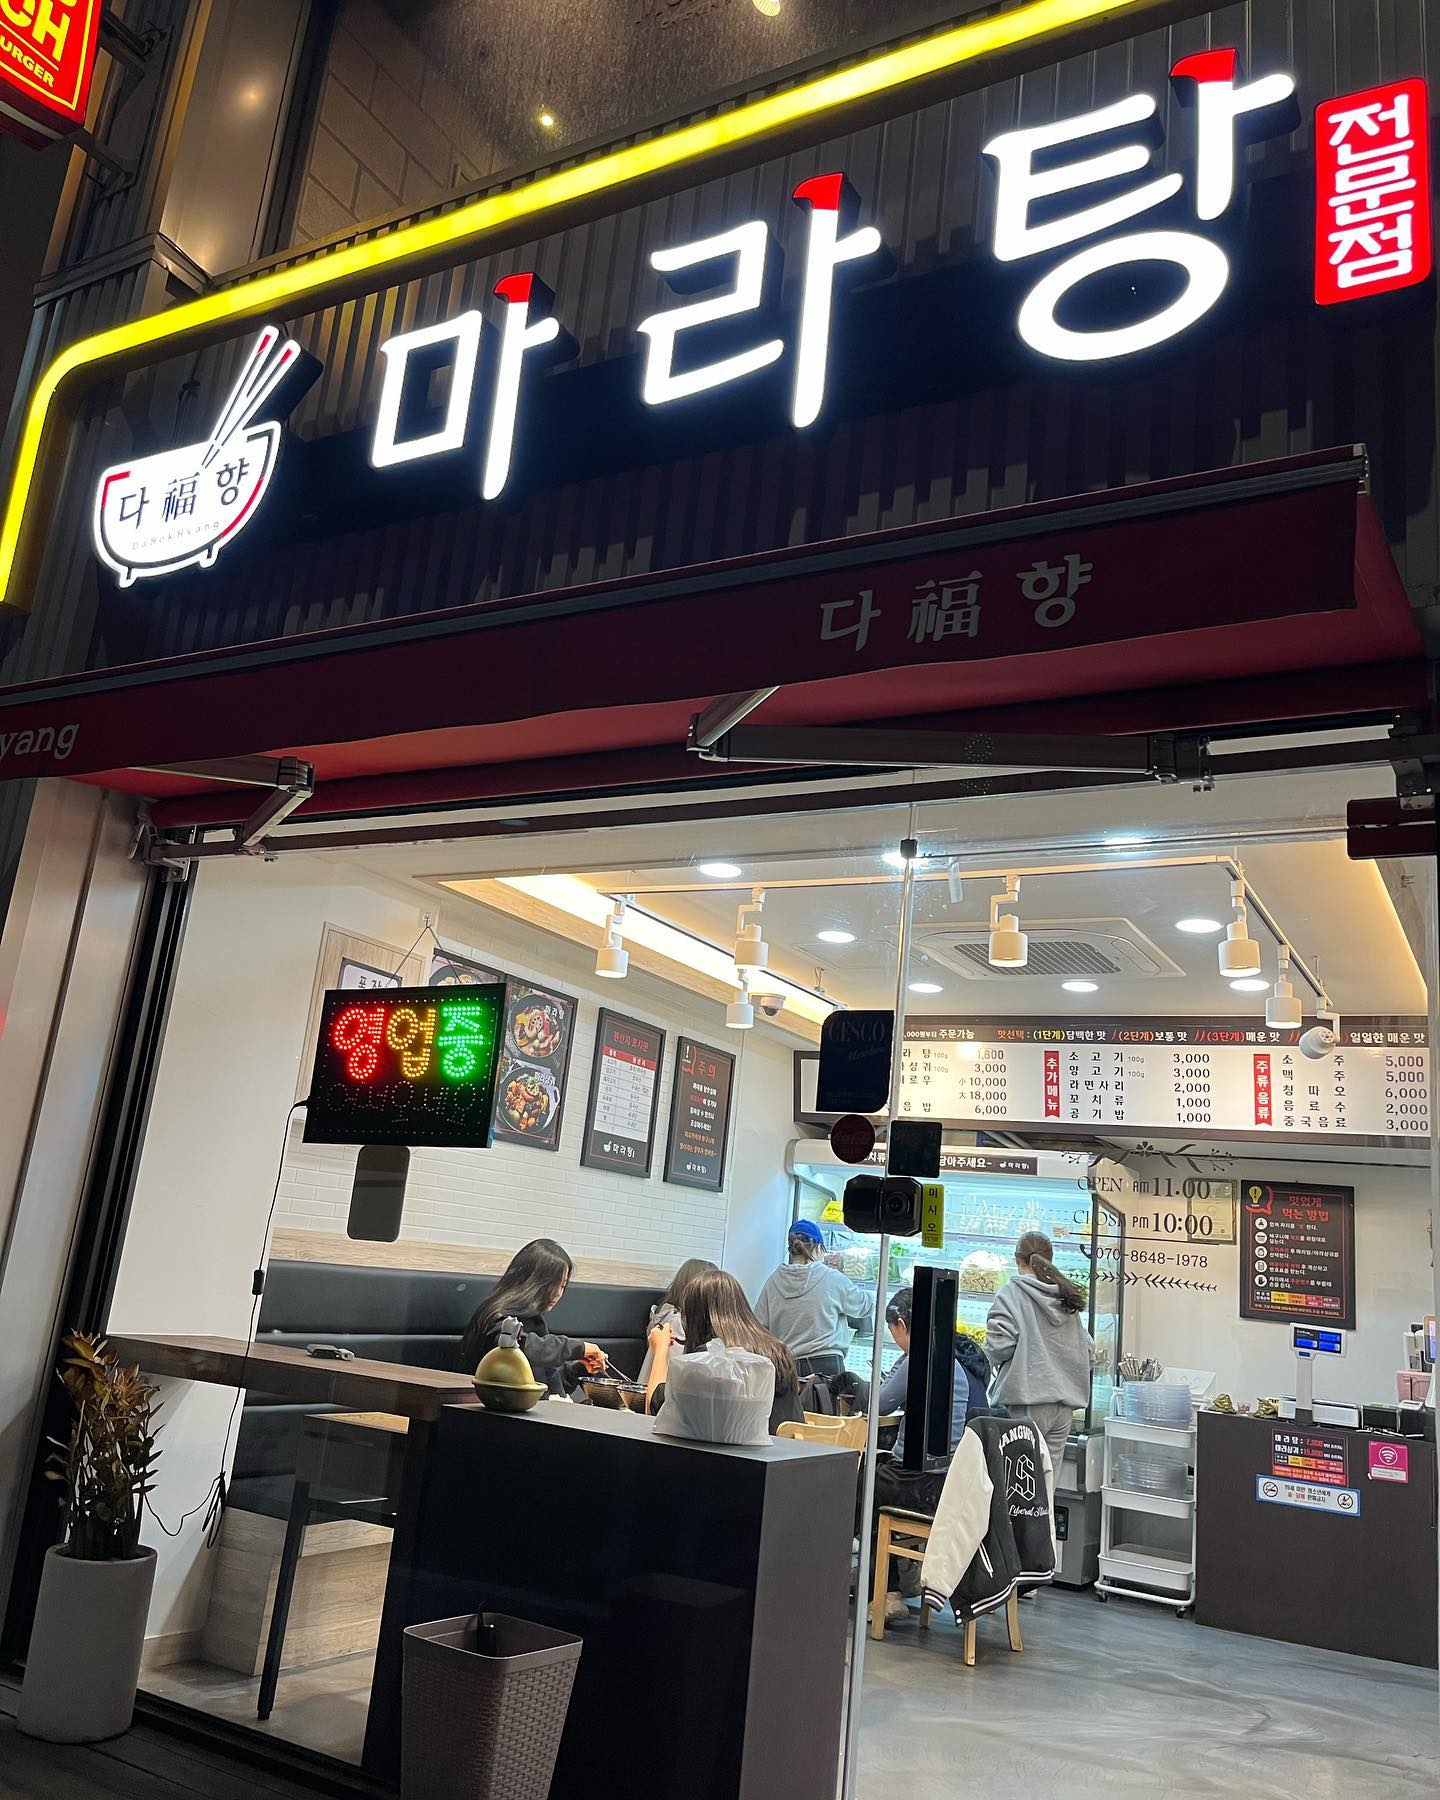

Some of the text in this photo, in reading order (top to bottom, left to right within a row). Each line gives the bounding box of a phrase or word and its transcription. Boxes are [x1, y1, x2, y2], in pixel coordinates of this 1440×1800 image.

[1327, 94, 1417, 288] 전문점
[371, 48, 1297, 501] 마라탕
[828, 1020, 886, 1042] CESCO
[939, 1029, 975, 1040] 주문가능
[1096, 1030, 1106, 1041] 맛
[1177, 1031, 1188, 1042] 맛
[1270, 1032, 1281, 1043] 맛
[1387, 1032, 1410, 1044] 매운
[1413, 1032, 1426, 1044] 맛
[333, 1006, 484, 1080] 영업중
[1127, 1055, 1145, 1064] 100g
[1173, 1053, 1210, 1065] 3,000
[1385, 1055, 1424, 1068] 5,000
[974, 1063, 1007, 1075] 3,000
[1128, 1070, 1145, 1079] 100g
[1173, 1068, 1210, 1079] 3,000
[969, 1077, 1007, 1088] 10,000
[1385, 1070, 1425, 1083] 5,000
[1046, 1057, 1058, 1112] 추가메뉴
[1173, 1082, 1211, 1094] 2,000
[969, 1091, 1007, 1102] 18,000
[1385, 1087, 1427, 1099] 6,000
[1176, 1097, 1211, 1109] 1,000
[1385, 1103, 1428, 1115] 2,000
[974, 1105, 1007, 1116] 6,000
[1176, 1112, 1212, 1124] 1,000
[1386, 1119, 1429, 1131] 3,000
[1077, 1176, 1123, 1193] OPEN
[927, 1188, 938, 1232] 미시오
[1282, 1208, 1329, 1222] 먹는 방법
[1152, 1212, 1213, 1236] 10:00
[1096, 1247, 1208, 1268] 070-8648-1978
